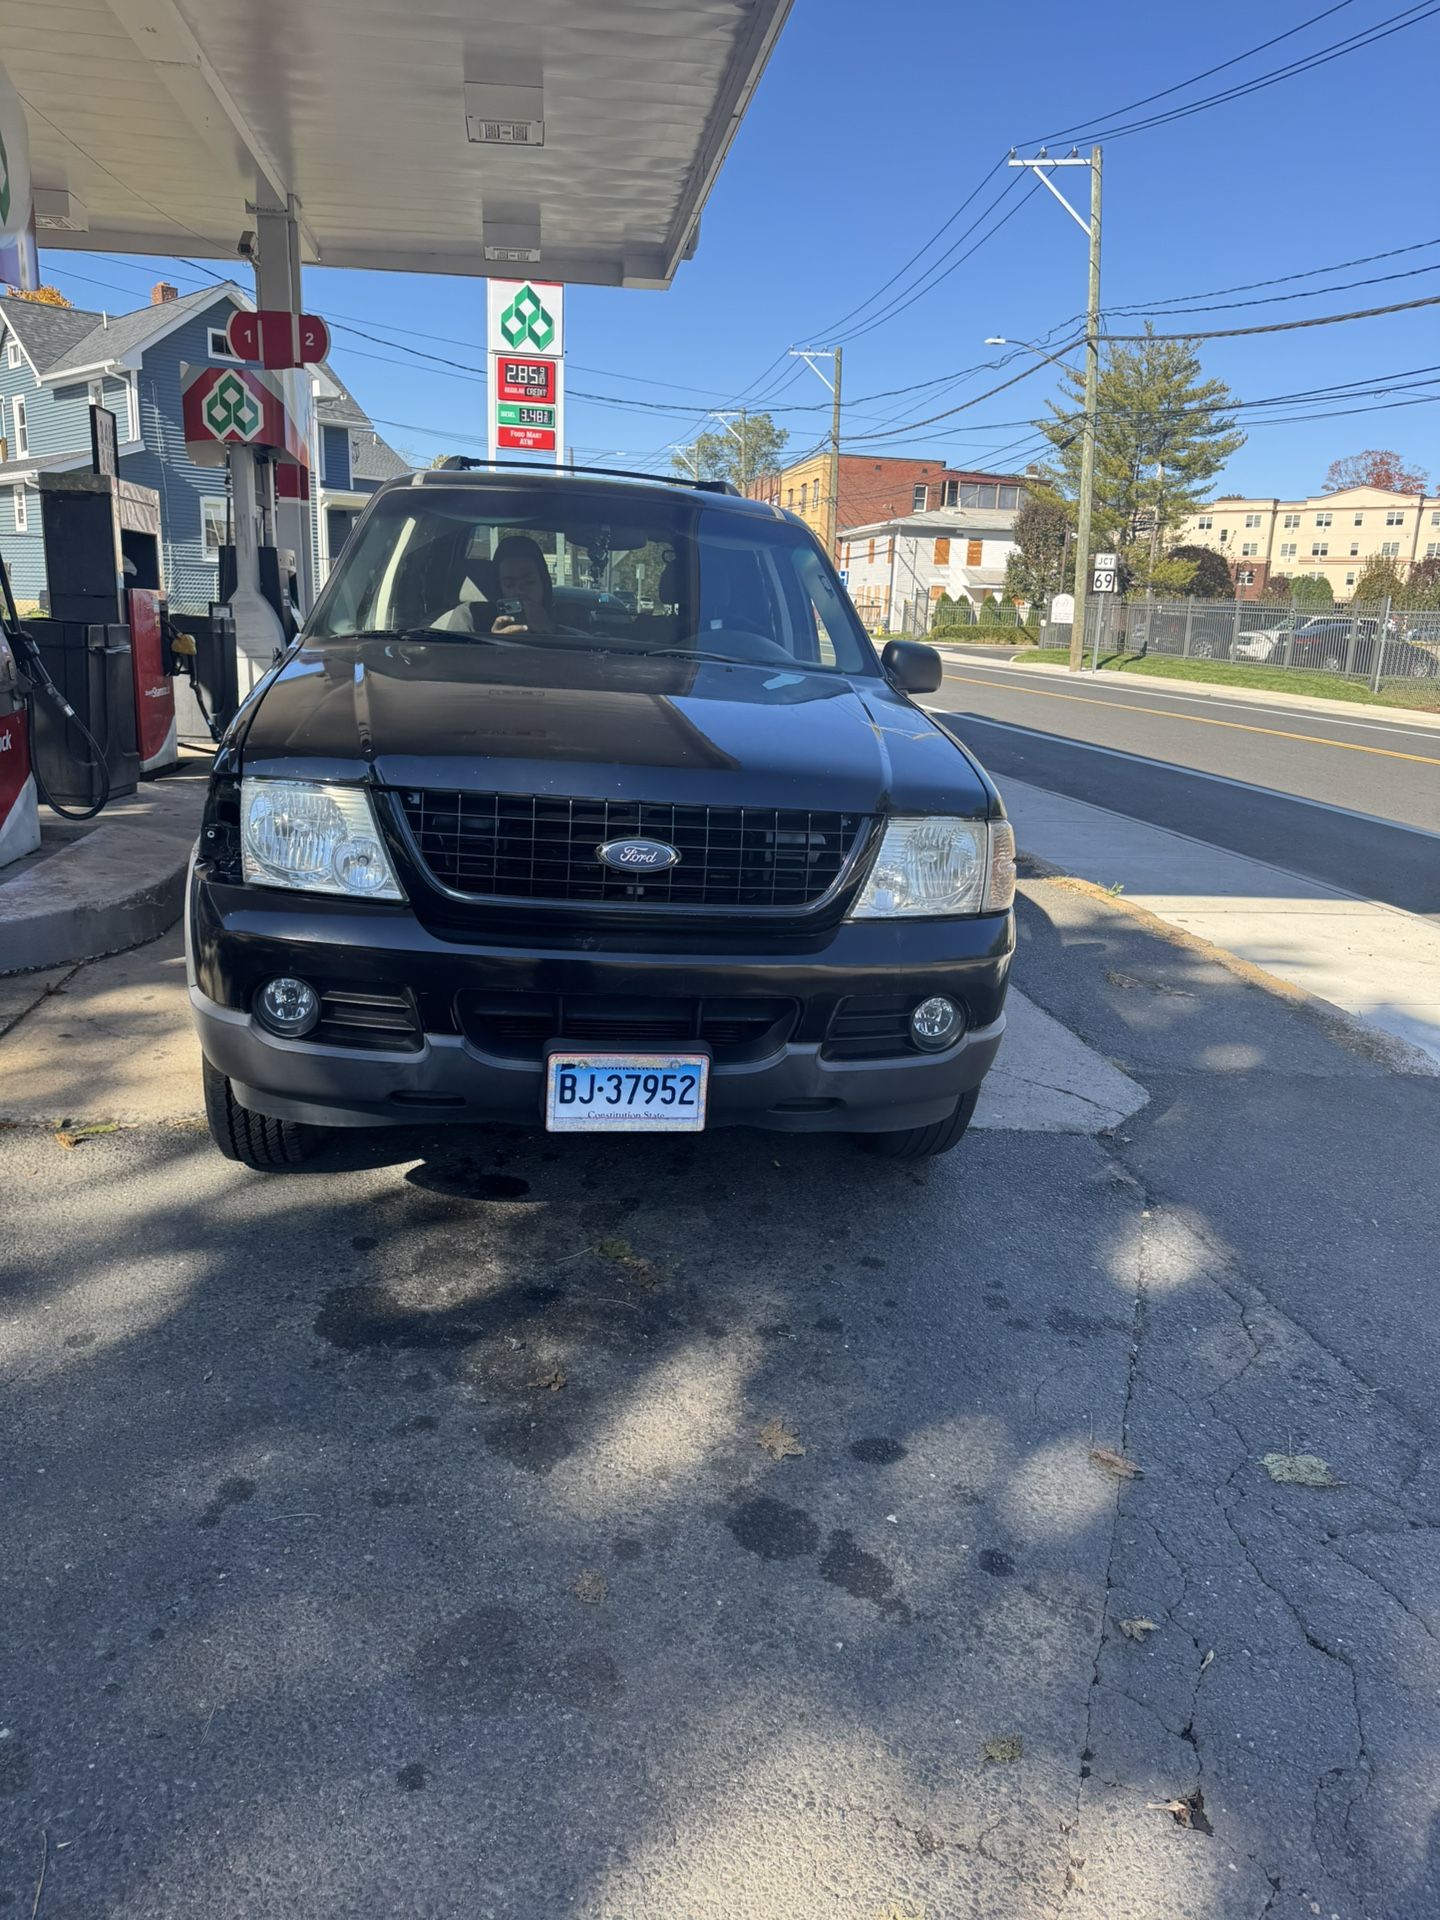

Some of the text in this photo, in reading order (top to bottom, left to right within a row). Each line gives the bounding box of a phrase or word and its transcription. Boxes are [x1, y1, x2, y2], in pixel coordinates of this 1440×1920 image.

[243, 330, 252, 343] 1
[305, 332, 315, 346] 2
[504, 386, 547, 396] REGULAR CREDIT
[520, 438, 533, 446] ATM
[1098, 557, 1113, 565] JCT
[1095, 574, 1112, 588] 69
[620, 846, 657, 863] Ford
[587, 1111, 665, 1119] Constitution State
